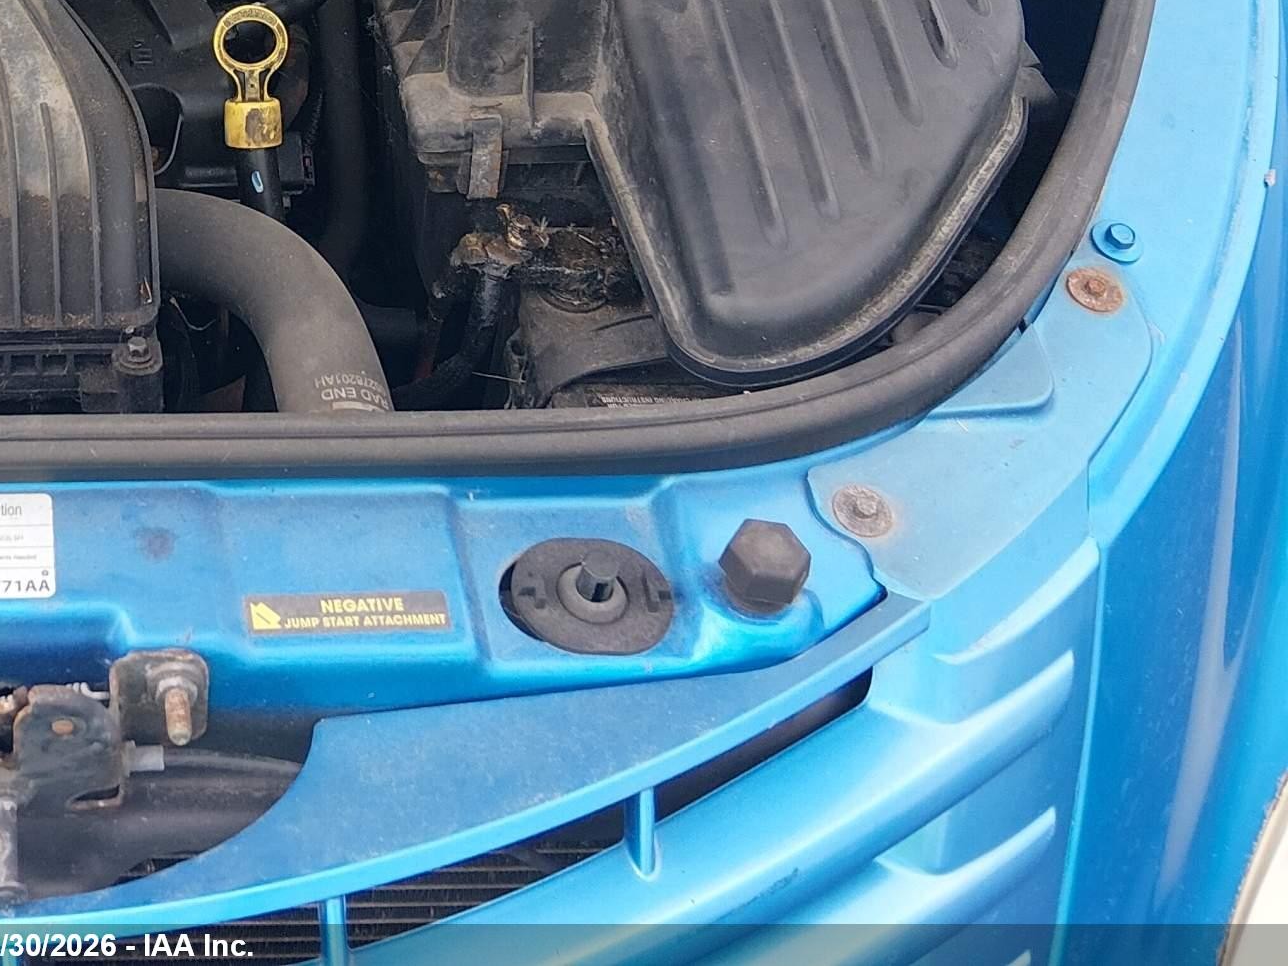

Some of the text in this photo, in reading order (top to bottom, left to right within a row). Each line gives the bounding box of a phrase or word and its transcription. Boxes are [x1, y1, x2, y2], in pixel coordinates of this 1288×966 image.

[321, 387, 390, 410] RAD END
[320, 597, 405, 614] NEGATIVE
[284, 613, 446, 629] JUMP START ATTACHMENT
